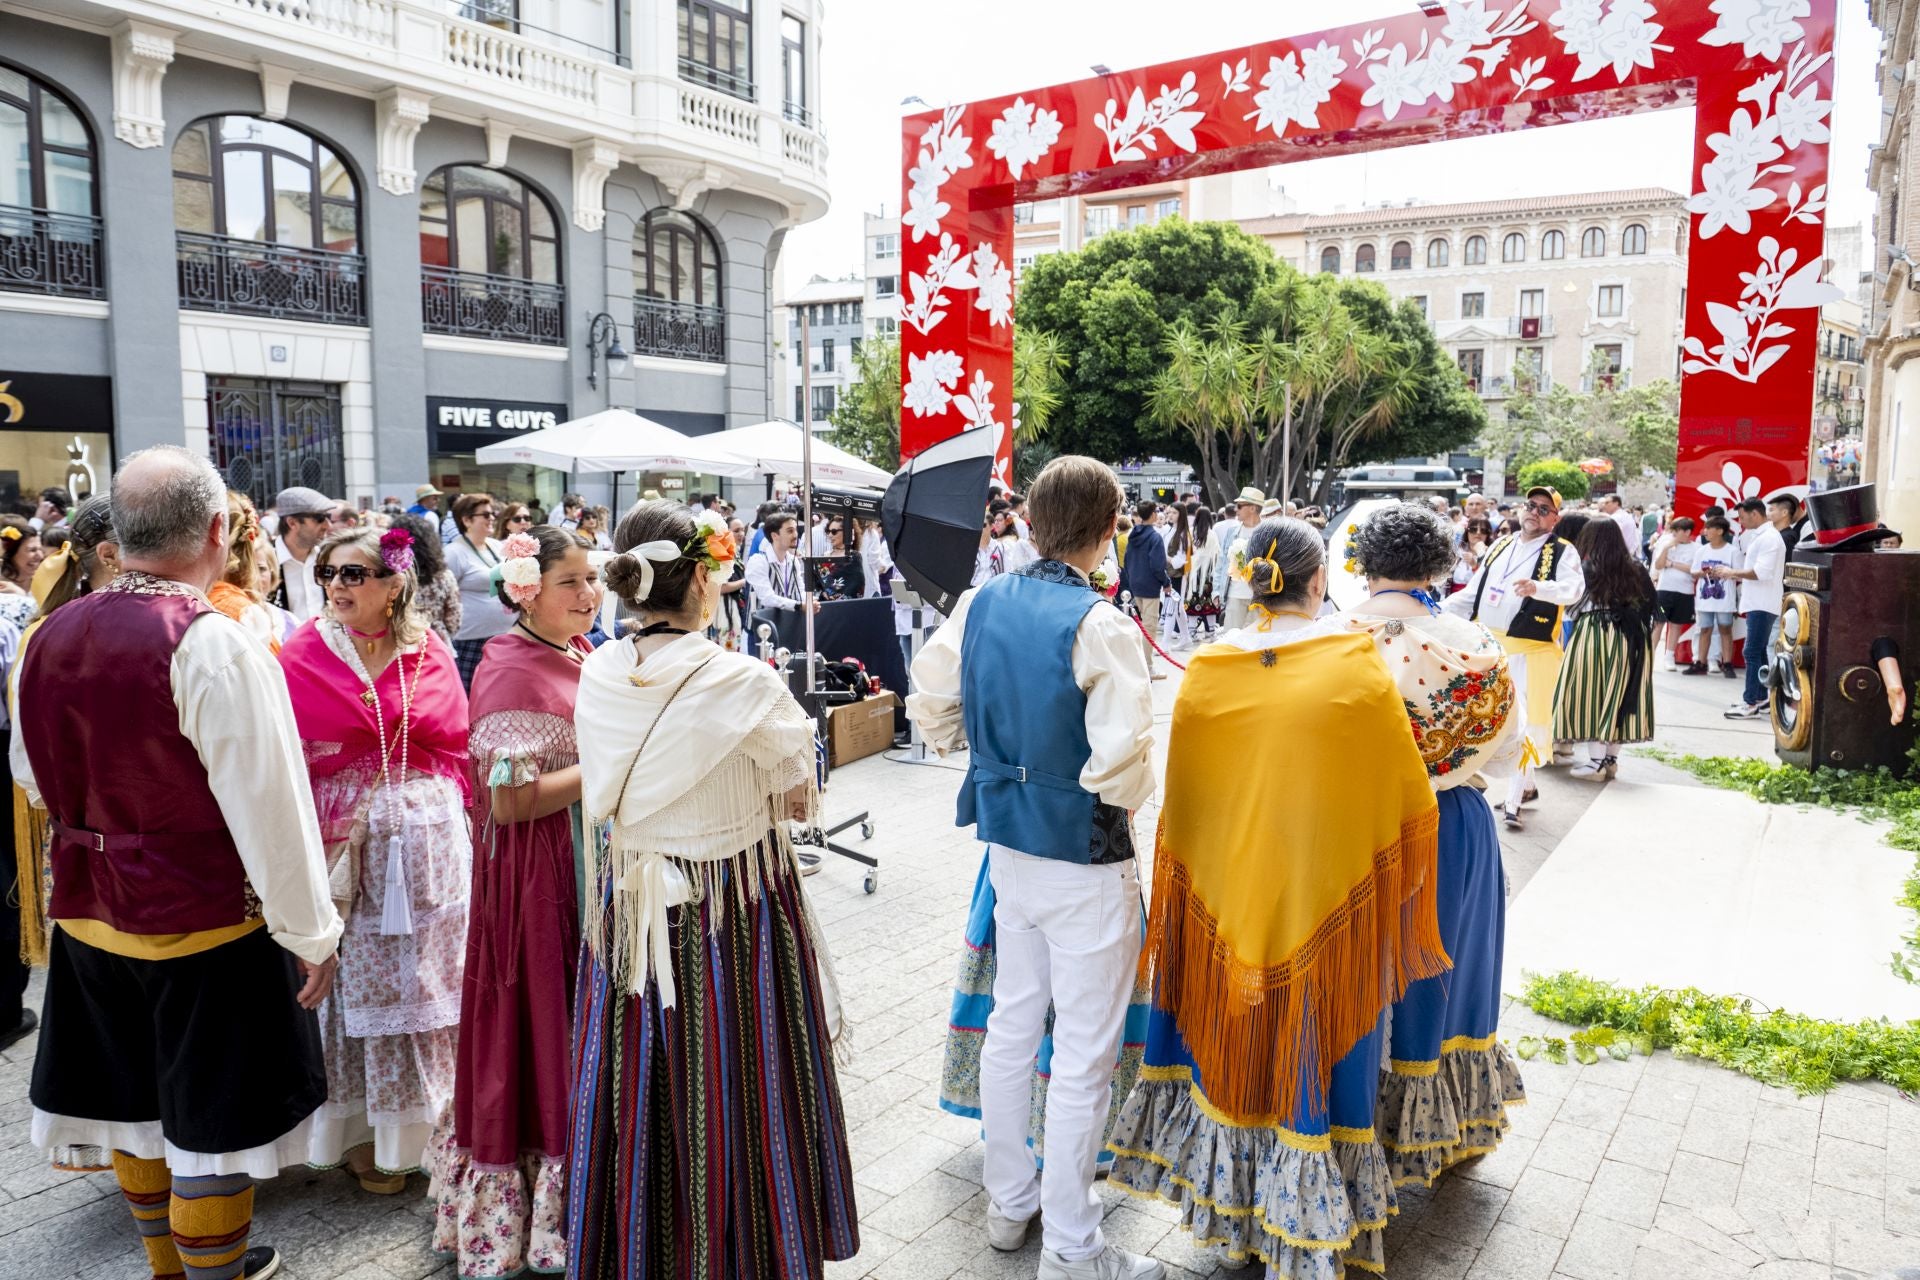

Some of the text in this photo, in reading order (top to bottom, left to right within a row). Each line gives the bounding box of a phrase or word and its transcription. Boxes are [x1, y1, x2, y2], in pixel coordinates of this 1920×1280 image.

[438, 406, 556, 429] FIVE GUYS
[661, 478, 683, 489] OPEN
